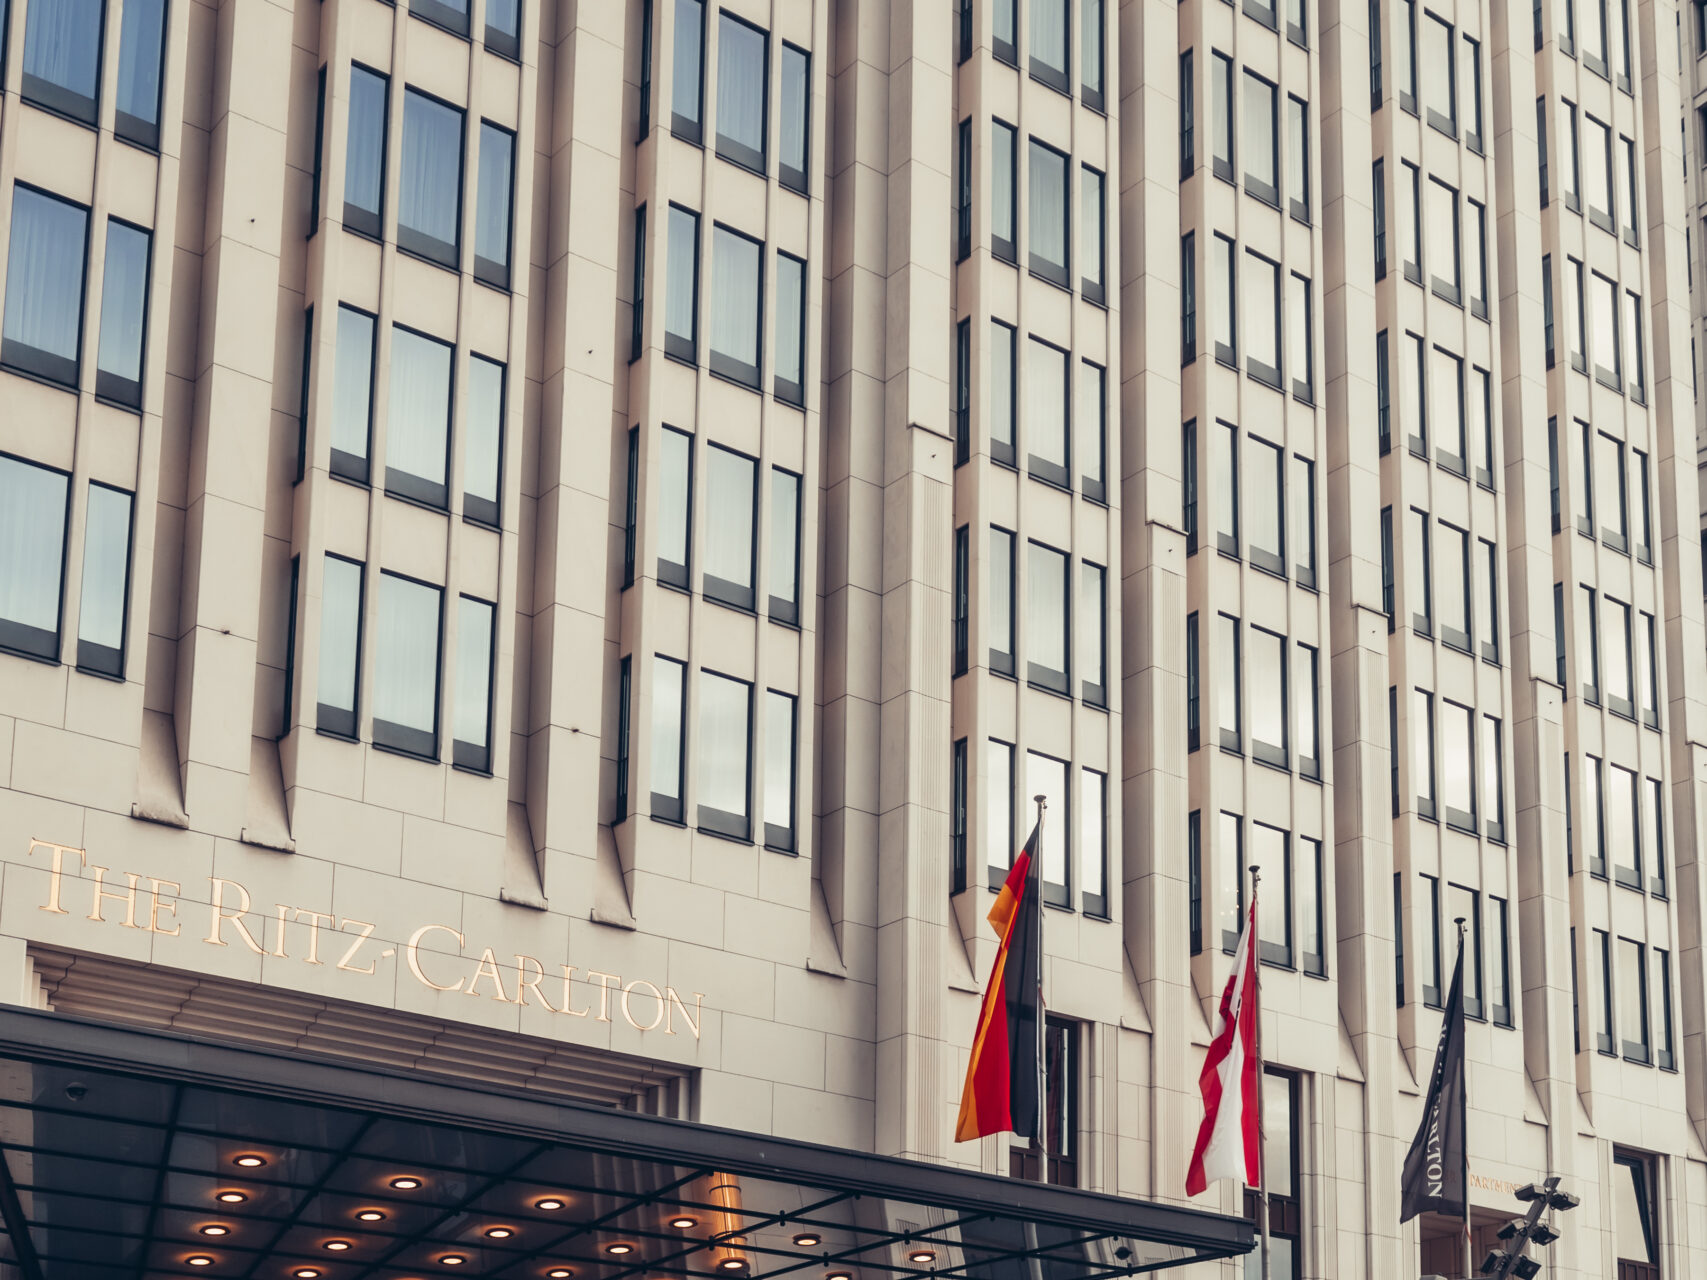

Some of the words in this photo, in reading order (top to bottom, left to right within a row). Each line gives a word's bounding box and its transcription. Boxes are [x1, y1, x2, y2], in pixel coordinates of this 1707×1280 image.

[29, 837, 181, 937] THE
[202, 876, 706, 1040] RITZ-CARLTON
[1470, 1174, 1525, 1195] PARTMEN
